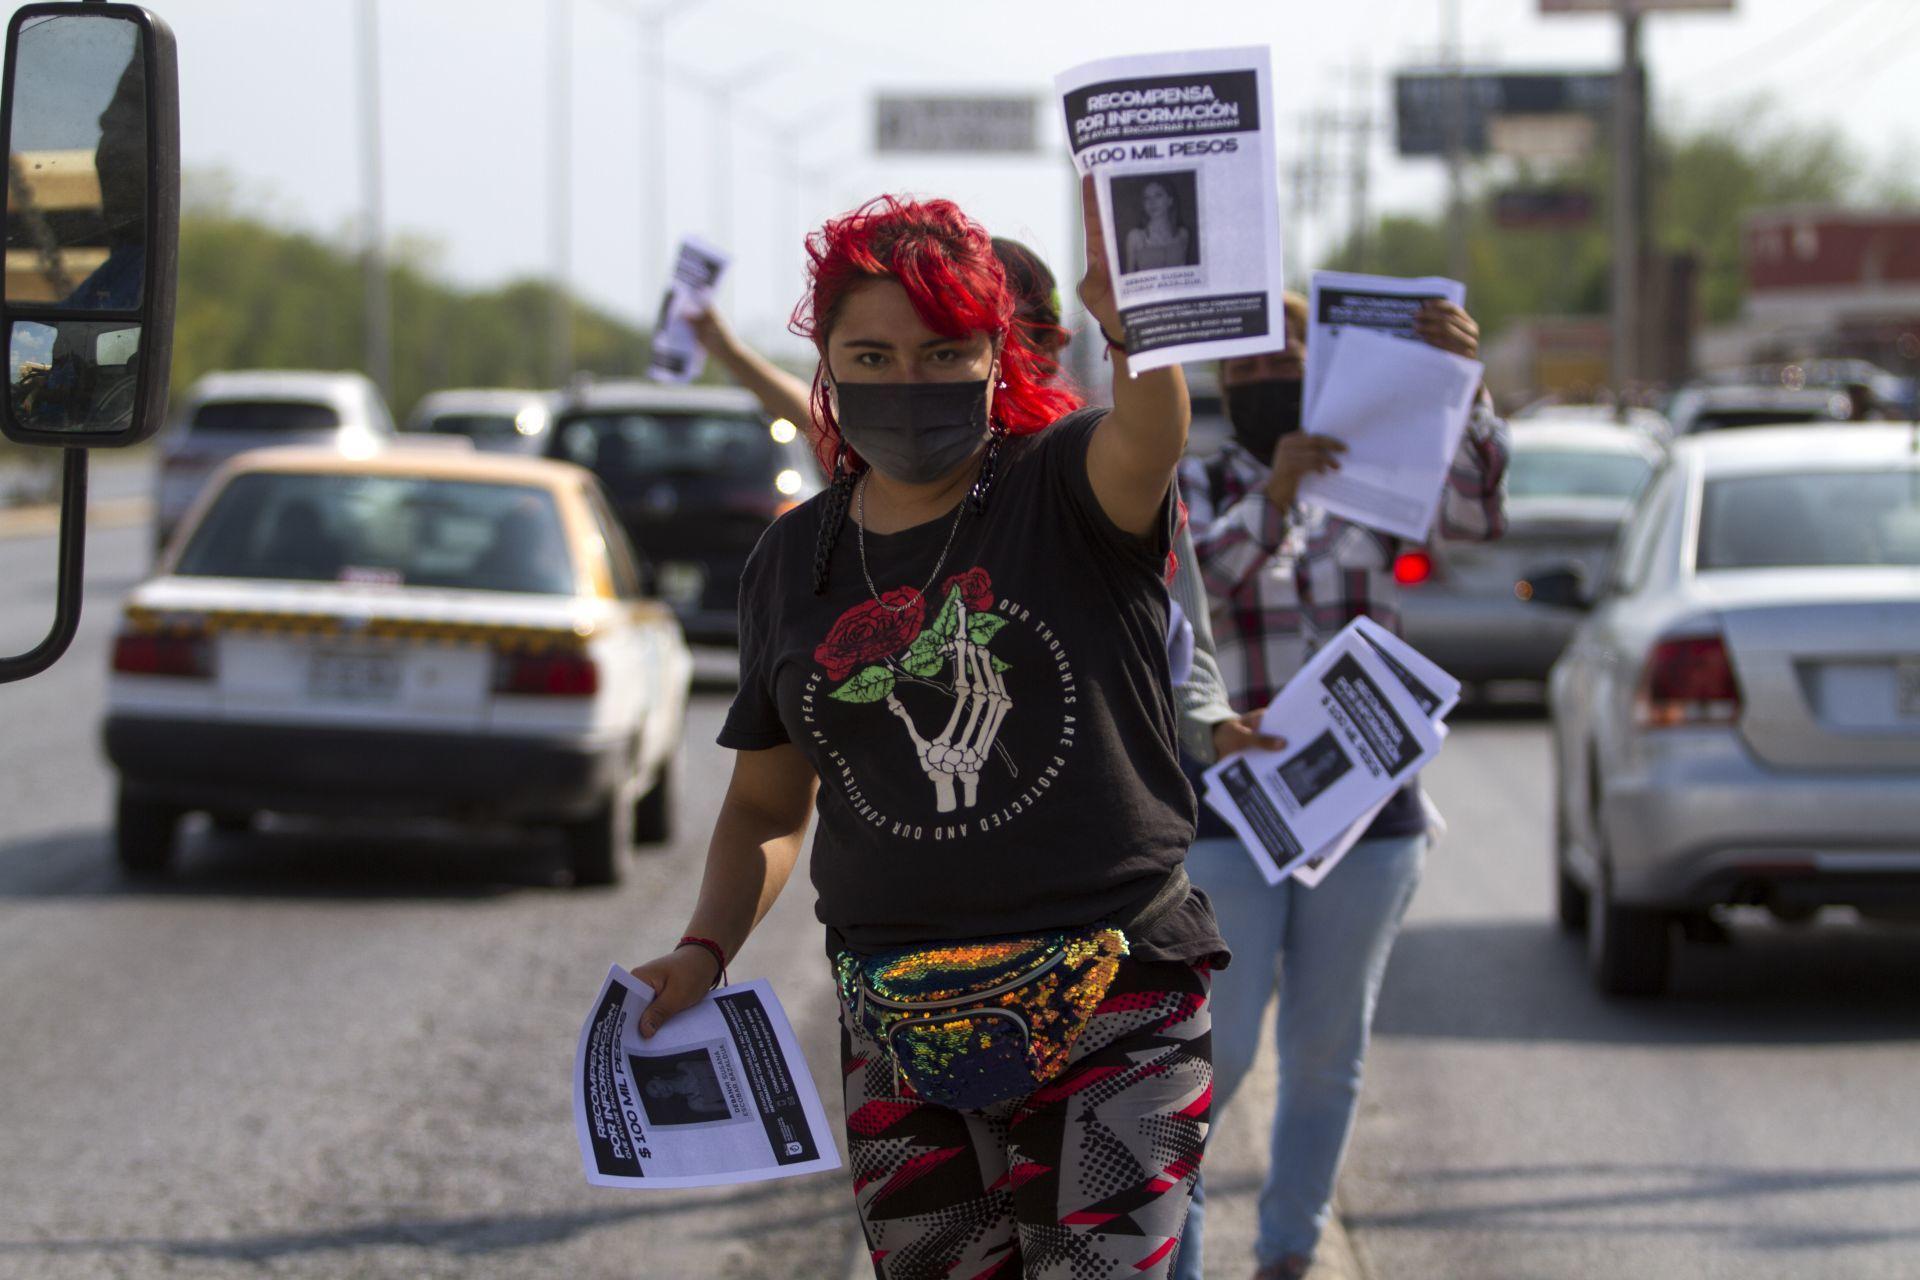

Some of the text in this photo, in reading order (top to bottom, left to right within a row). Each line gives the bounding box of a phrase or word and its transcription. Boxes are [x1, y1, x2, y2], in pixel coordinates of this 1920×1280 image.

[1075, 100, 1238, 135] POR INFORMACIÓN
[1087, 85, 1215, 113] RECOMPENSA
[1090, 147, 1125, 166] 100
[1131, 144, 1164, 160] MIL
[1169, 138, 1239, 157] PESOS
[802, 599, 1077, 840] OUR THOUGHTS ARE PROTECTED AND OUR CONSCIENCE IN PEACE
[589, 1020, 607, 1138] RECOMPENSA
[598, 1003, 625, 1159] POR INFORMACIÓN
[614, 1011, 651, 1159] $ 100 MIL PESOS
